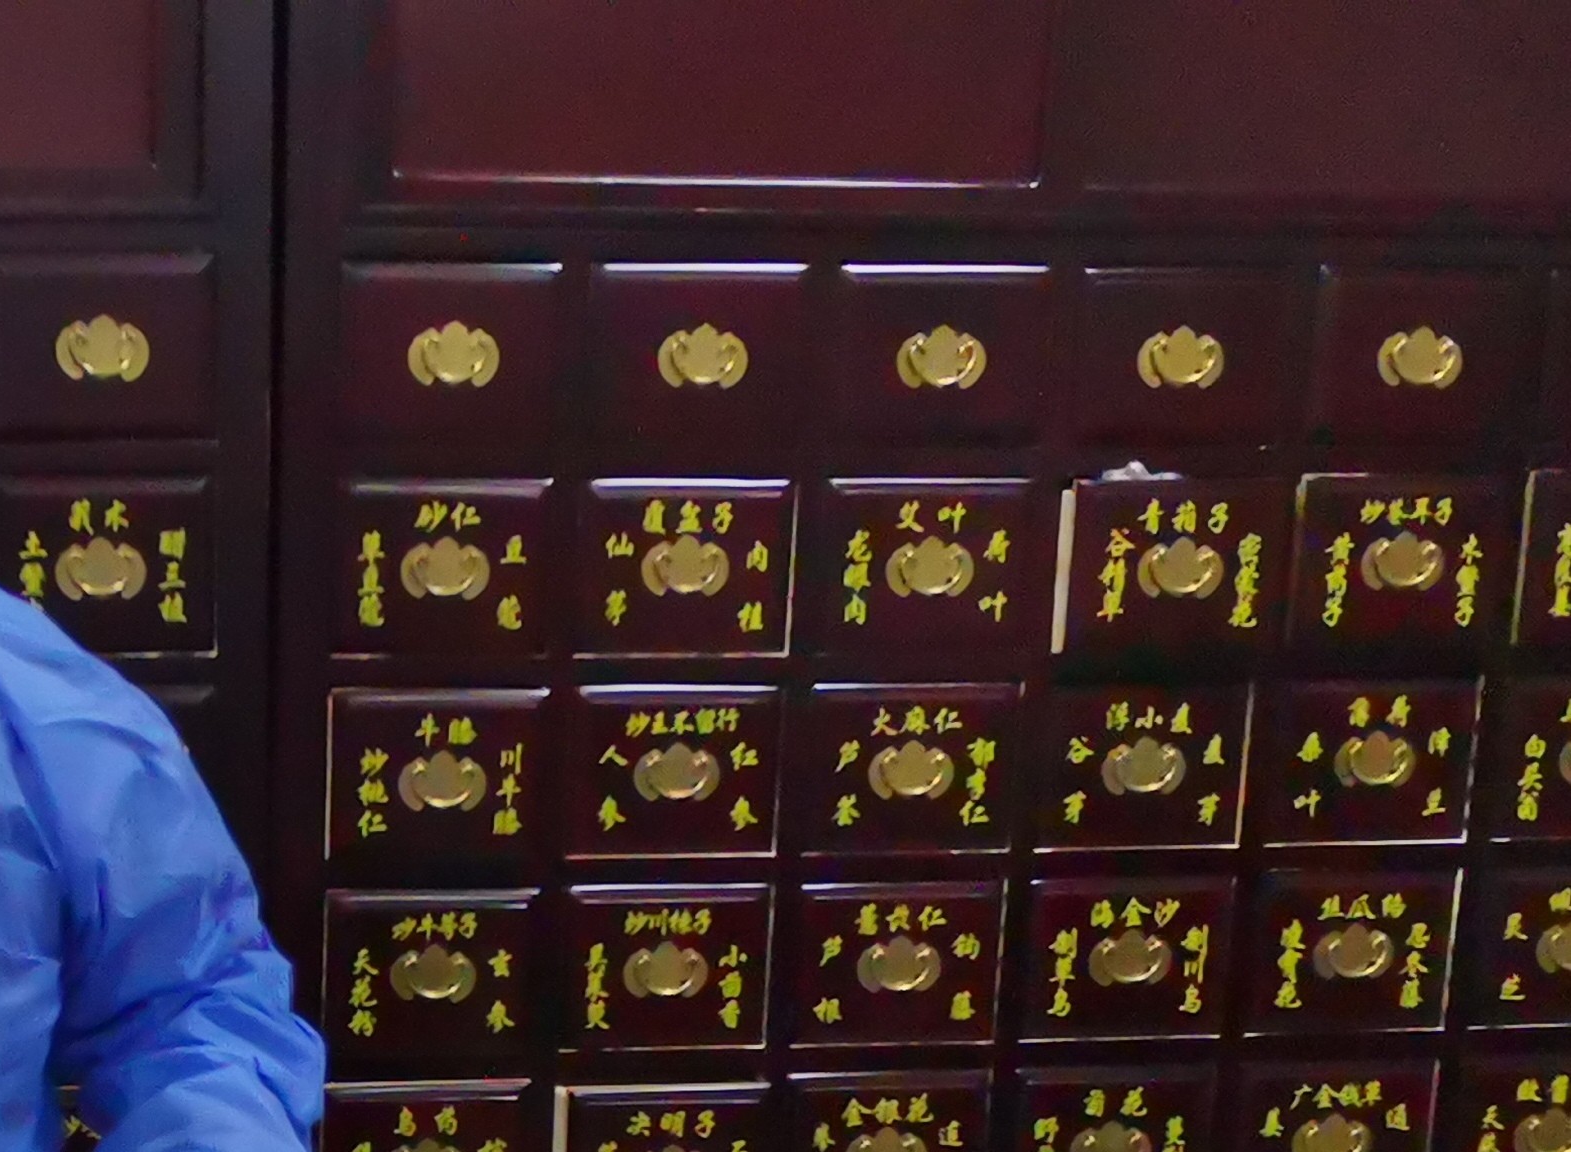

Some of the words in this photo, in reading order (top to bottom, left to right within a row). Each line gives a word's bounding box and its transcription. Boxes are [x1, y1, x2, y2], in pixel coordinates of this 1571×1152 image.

[897, 500, 968, 533] 艾叶
[1139, 499, 1231, 535] 青葙子
[604, 533, 635, 627] 仙茅
[737, 541, 769, 633] 肉桂
[842, 528, 874, 626] 龙眼肉
[416, 714, 478, 747] 牛膝
[624, 708, 741, 738] 炒王不留行
[872, 705, 964, 737] 火麻仁
[1105, 700, 1194, 736] 浮小麦
[493, 742, 524, 836] 川牛膝
[598, 745, 628, 831] 人参
[729, 741, 760, 831] 红参
[958, 737, 998, 826] 郁李仁
[1063, 736, 1095, 825] 谷芽
[1198, 734, 1226, 826] 麦芽
[392, 911, 478, 941] 炒牛蒡子
[1090, 897, 1181, 931] 海金沙
[348, 947, 380, 1037] 天花粉
[486, 948, 516, 1033] 玄参
[718, 944, 748, 1030] 小茴香
[1048, 927, 1079, 1018] 制草乌
[1179, 924, 1210, 1015] 制川乌
[396, 1106, 459, 1138] 乌药
[626, 1109, 717, 1138] 决明子
[841, 1093, 935, 1130] 金银花
